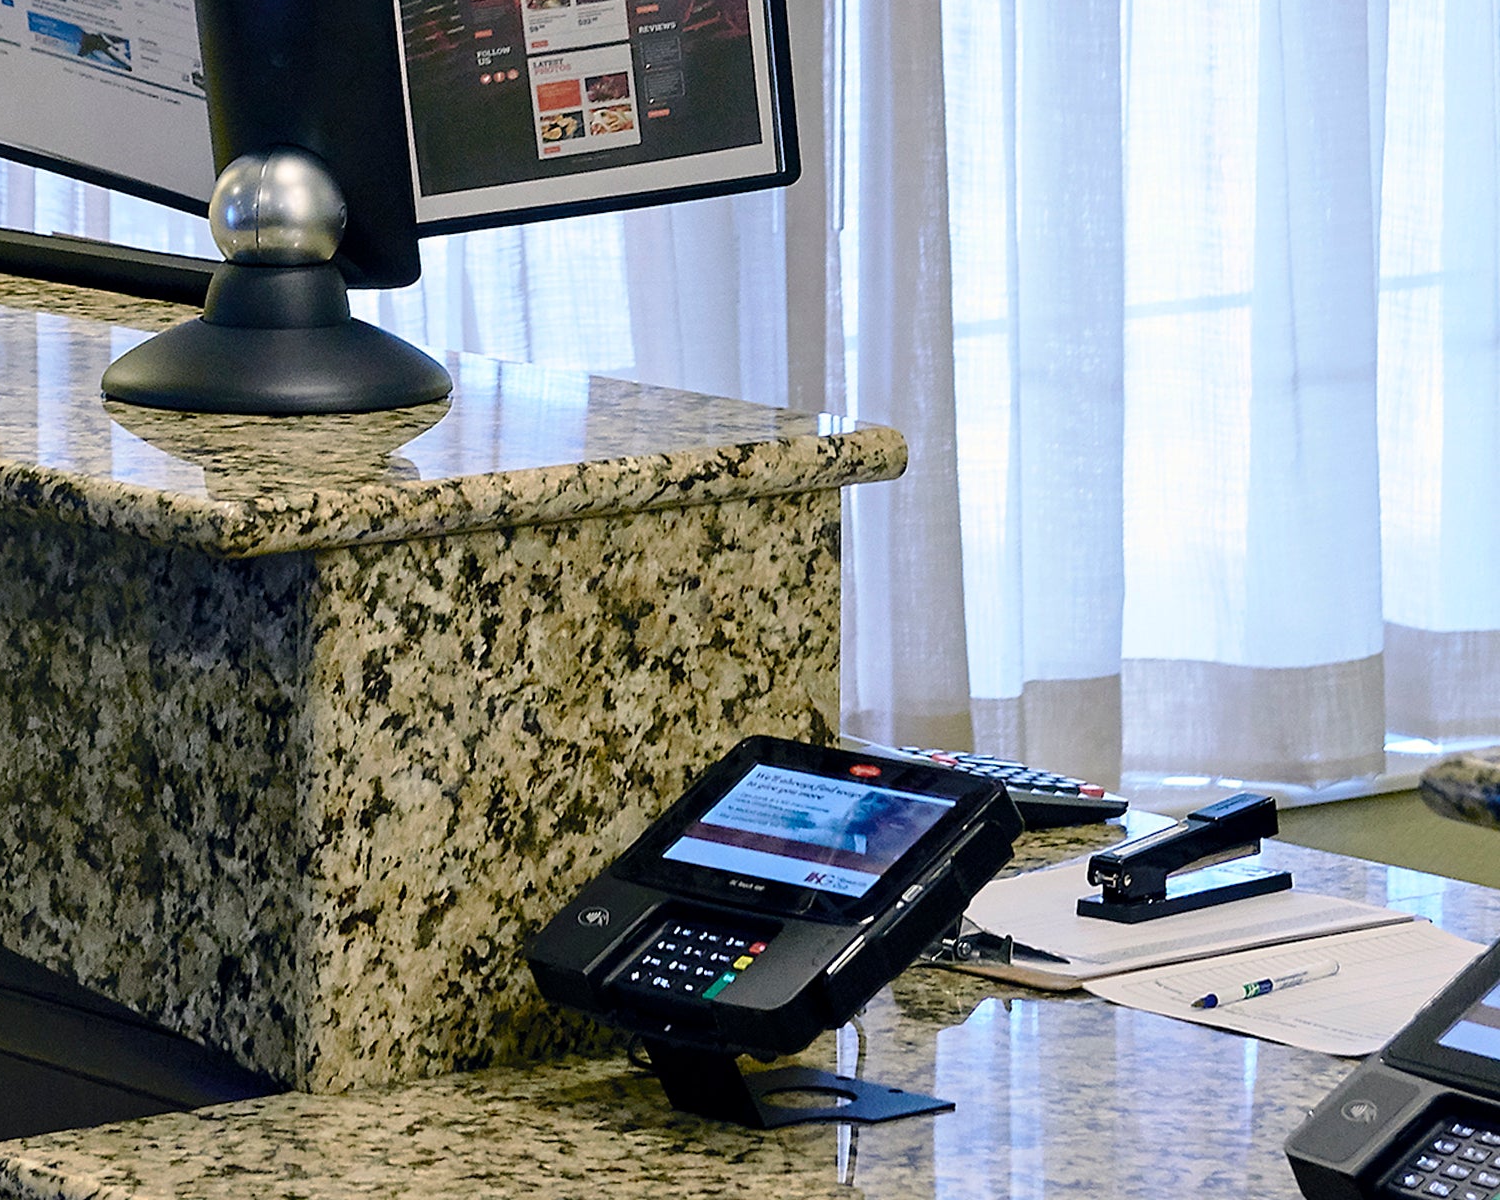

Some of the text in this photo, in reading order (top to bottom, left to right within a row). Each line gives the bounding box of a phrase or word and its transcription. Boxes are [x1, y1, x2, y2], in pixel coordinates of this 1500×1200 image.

[638, 21, 676, 34] REVIEWS
[476, 46, 511, 58] FOLLOW
[478, 58, 492, 66] US
[534, 64, 571, 75] PHOTOS
[799, 790, 825, 800] more
